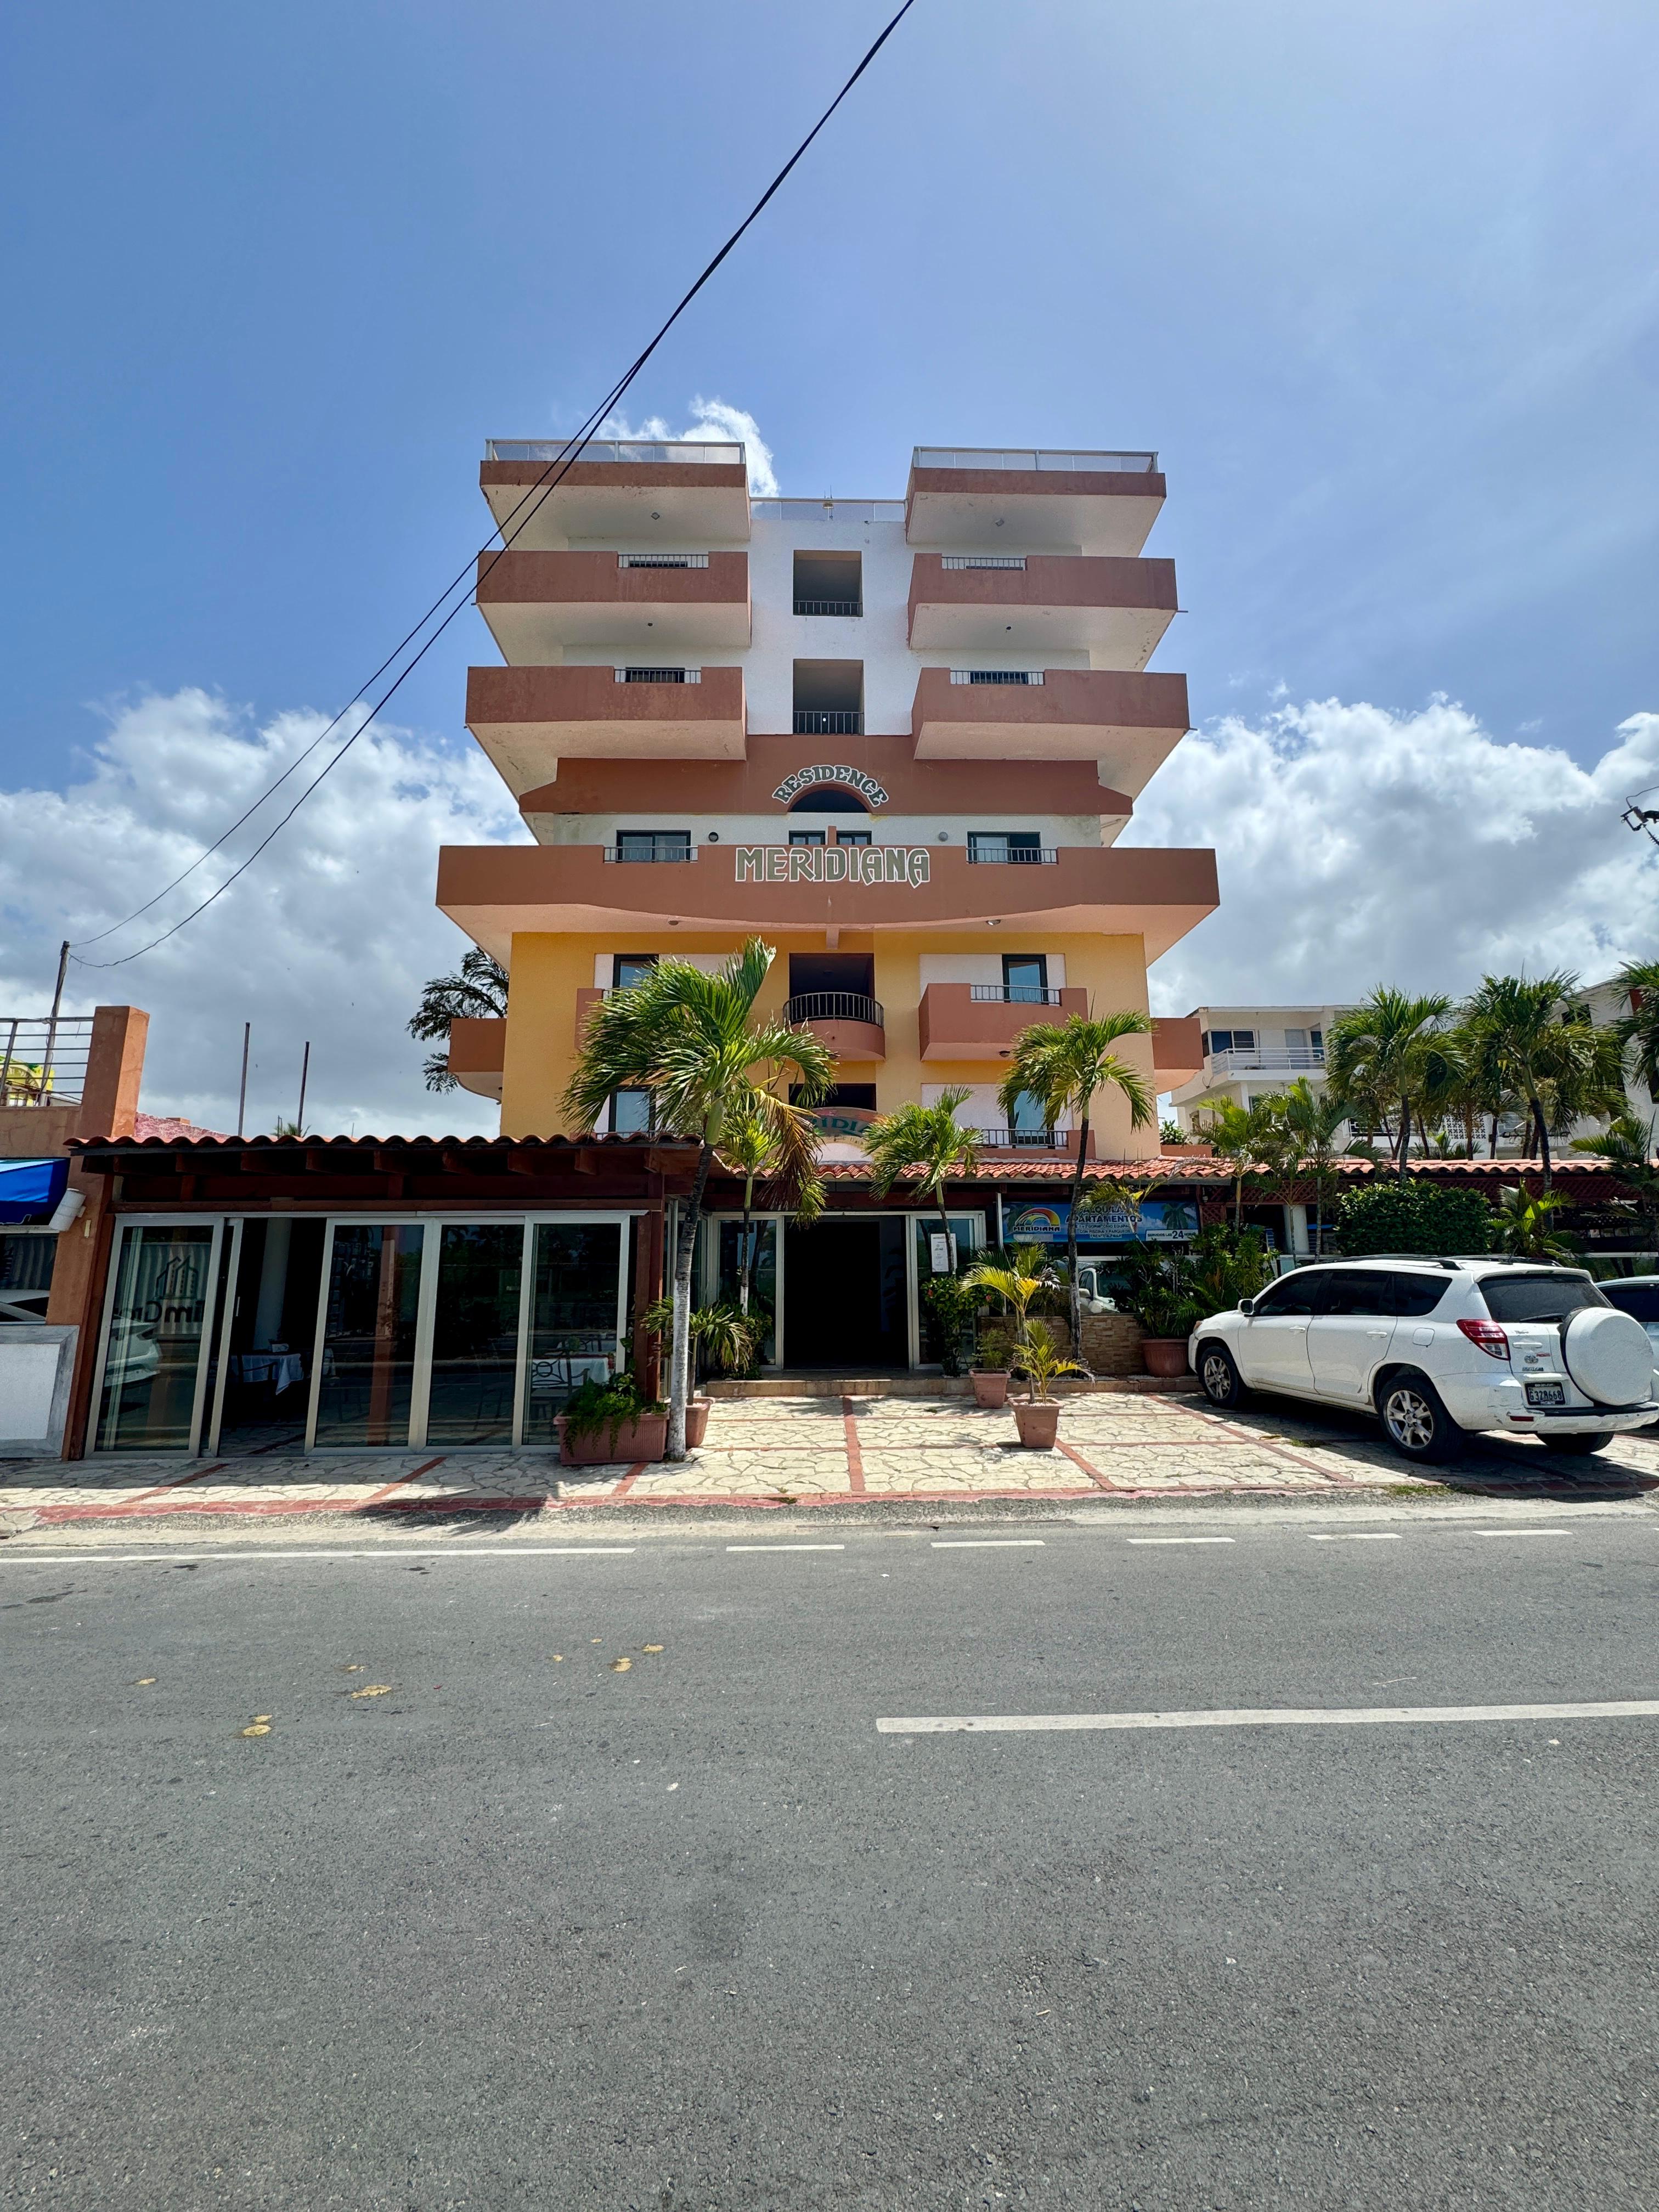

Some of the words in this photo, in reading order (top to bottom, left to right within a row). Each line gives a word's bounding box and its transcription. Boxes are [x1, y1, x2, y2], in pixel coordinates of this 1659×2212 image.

[772, 764, 889, 808] RESIDENCE
[735, 847, 930, 889] MERIDIANA
[1172, 1231, 1184, 1239] 24
